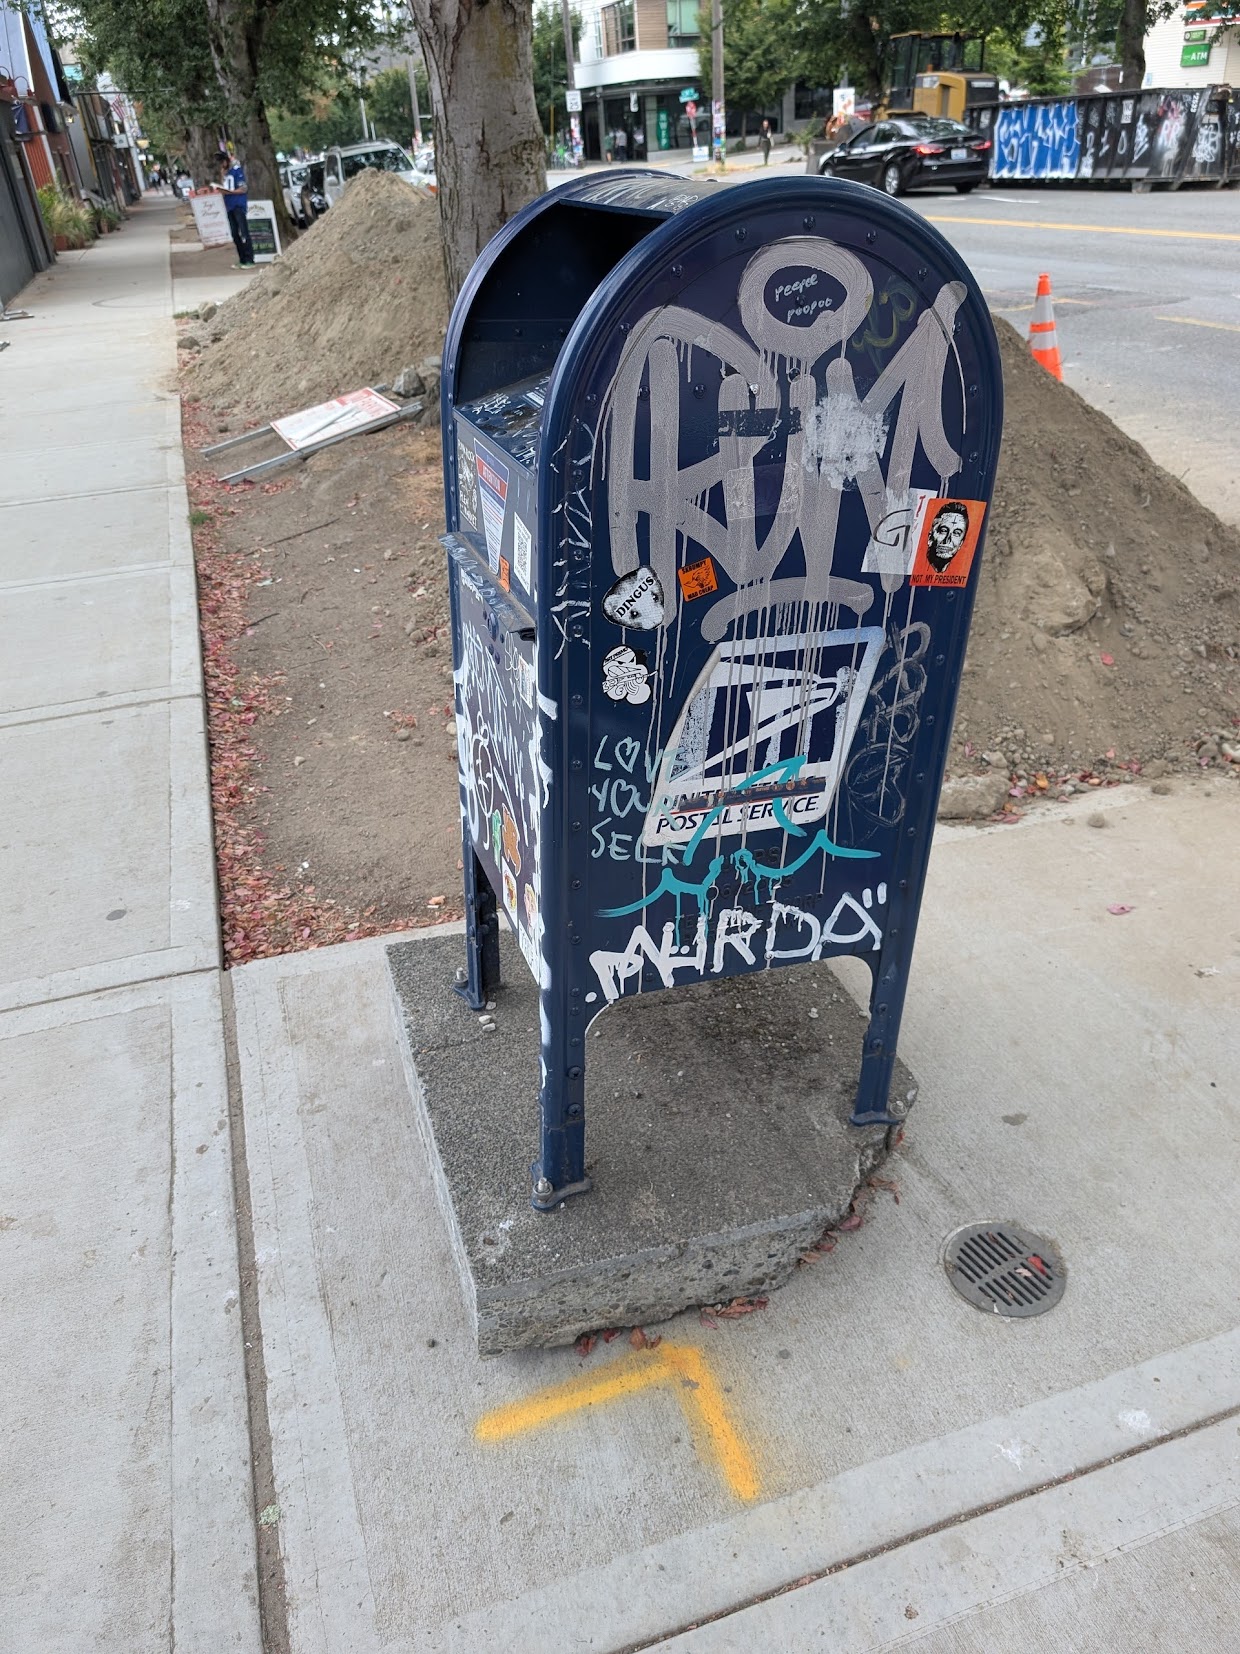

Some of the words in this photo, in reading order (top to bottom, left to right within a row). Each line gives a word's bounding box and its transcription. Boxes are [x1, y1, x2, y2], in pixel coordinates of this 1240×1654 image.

[1190, 52, 1208, 61] ATM
[570, 102, 580, 110] 25
[911, 574, 924, 584] NOT
[925, 574, 935, 583] MY
[934, 574, 967, 585] PRESIDENT
[616, 576, 656, 618] DINGUS
